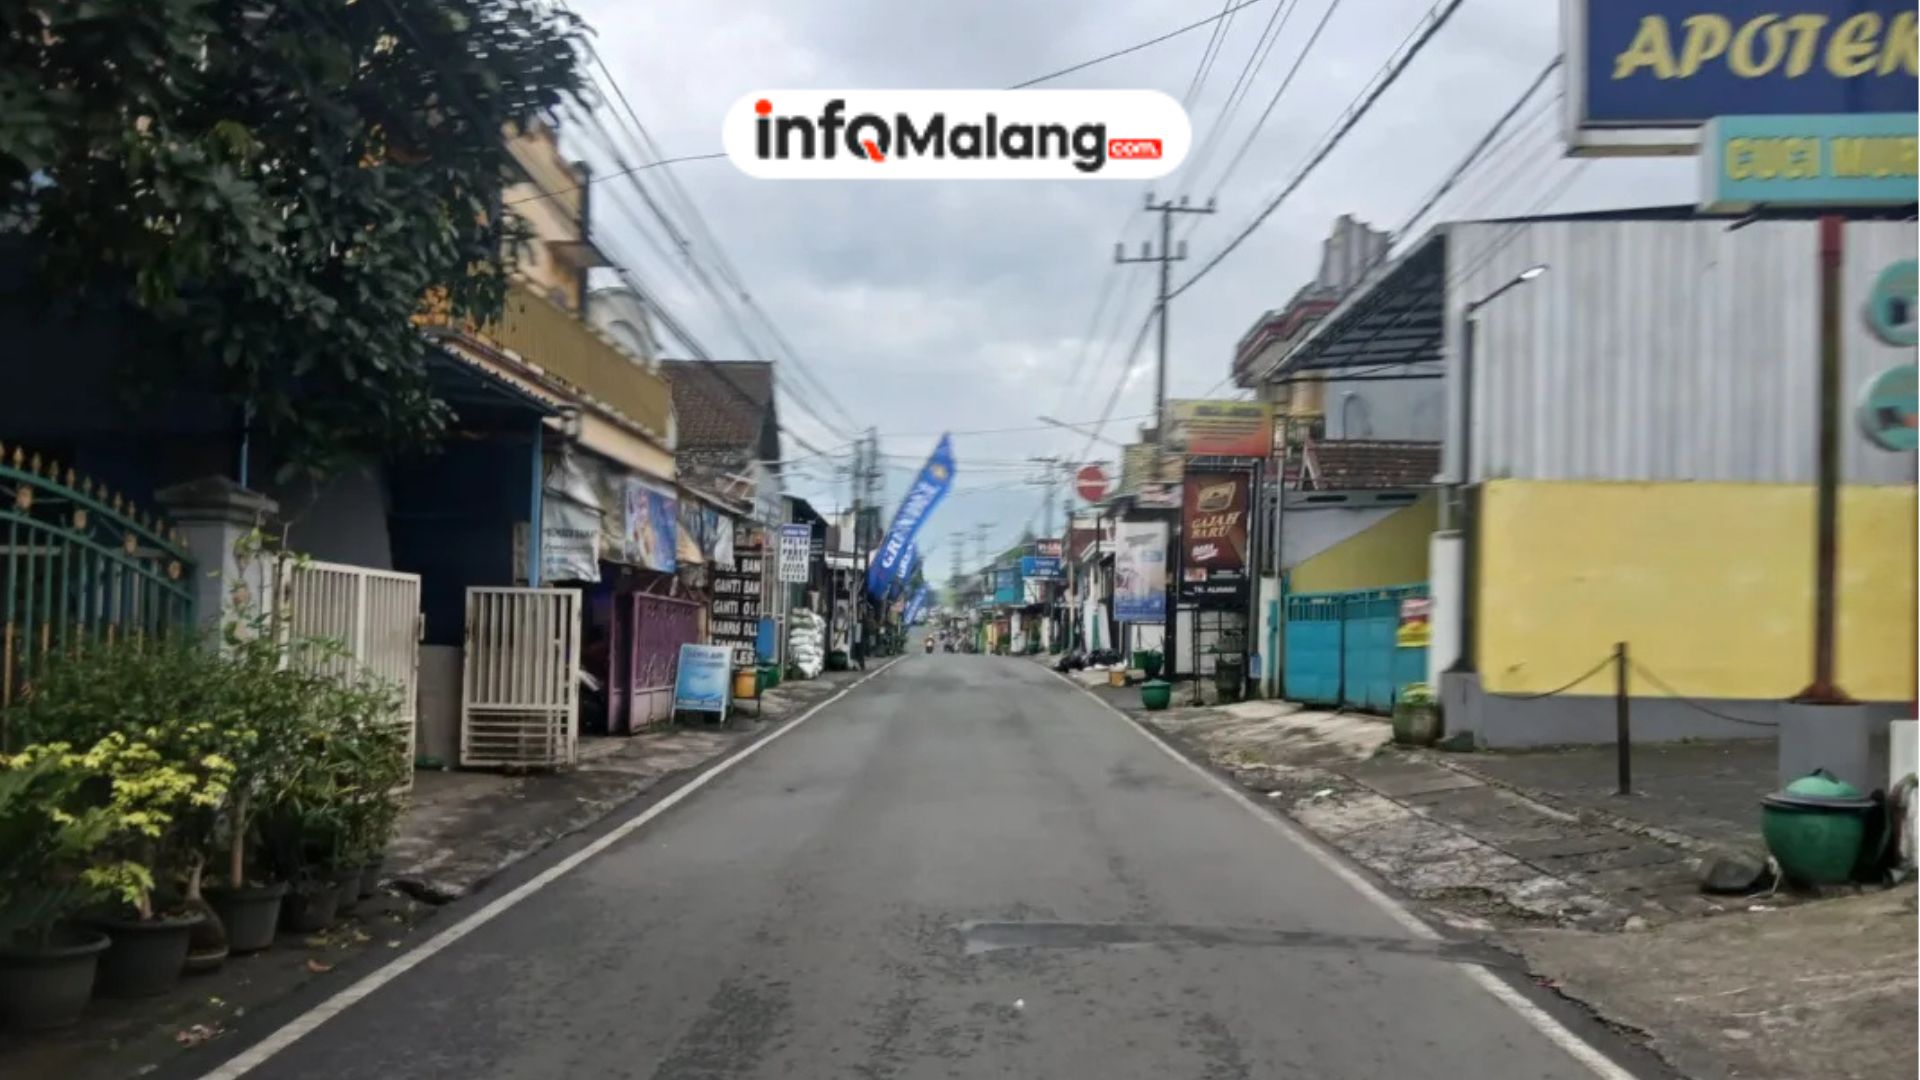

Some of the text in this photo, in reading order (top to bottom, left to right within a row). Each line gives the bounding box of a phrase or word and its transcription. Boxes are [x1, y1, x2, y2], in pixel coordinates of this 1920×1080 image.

[1726, 136, 1821, 180] CUCI
[1191, 511, 1242, 529] GAJAH
[1191, 526, 1231, 539] BARU
[742, 559, 761, 573] BAN
[714, 578, 761, 594] GANTI BAN
[713, 599, 738, 614] GANTI
